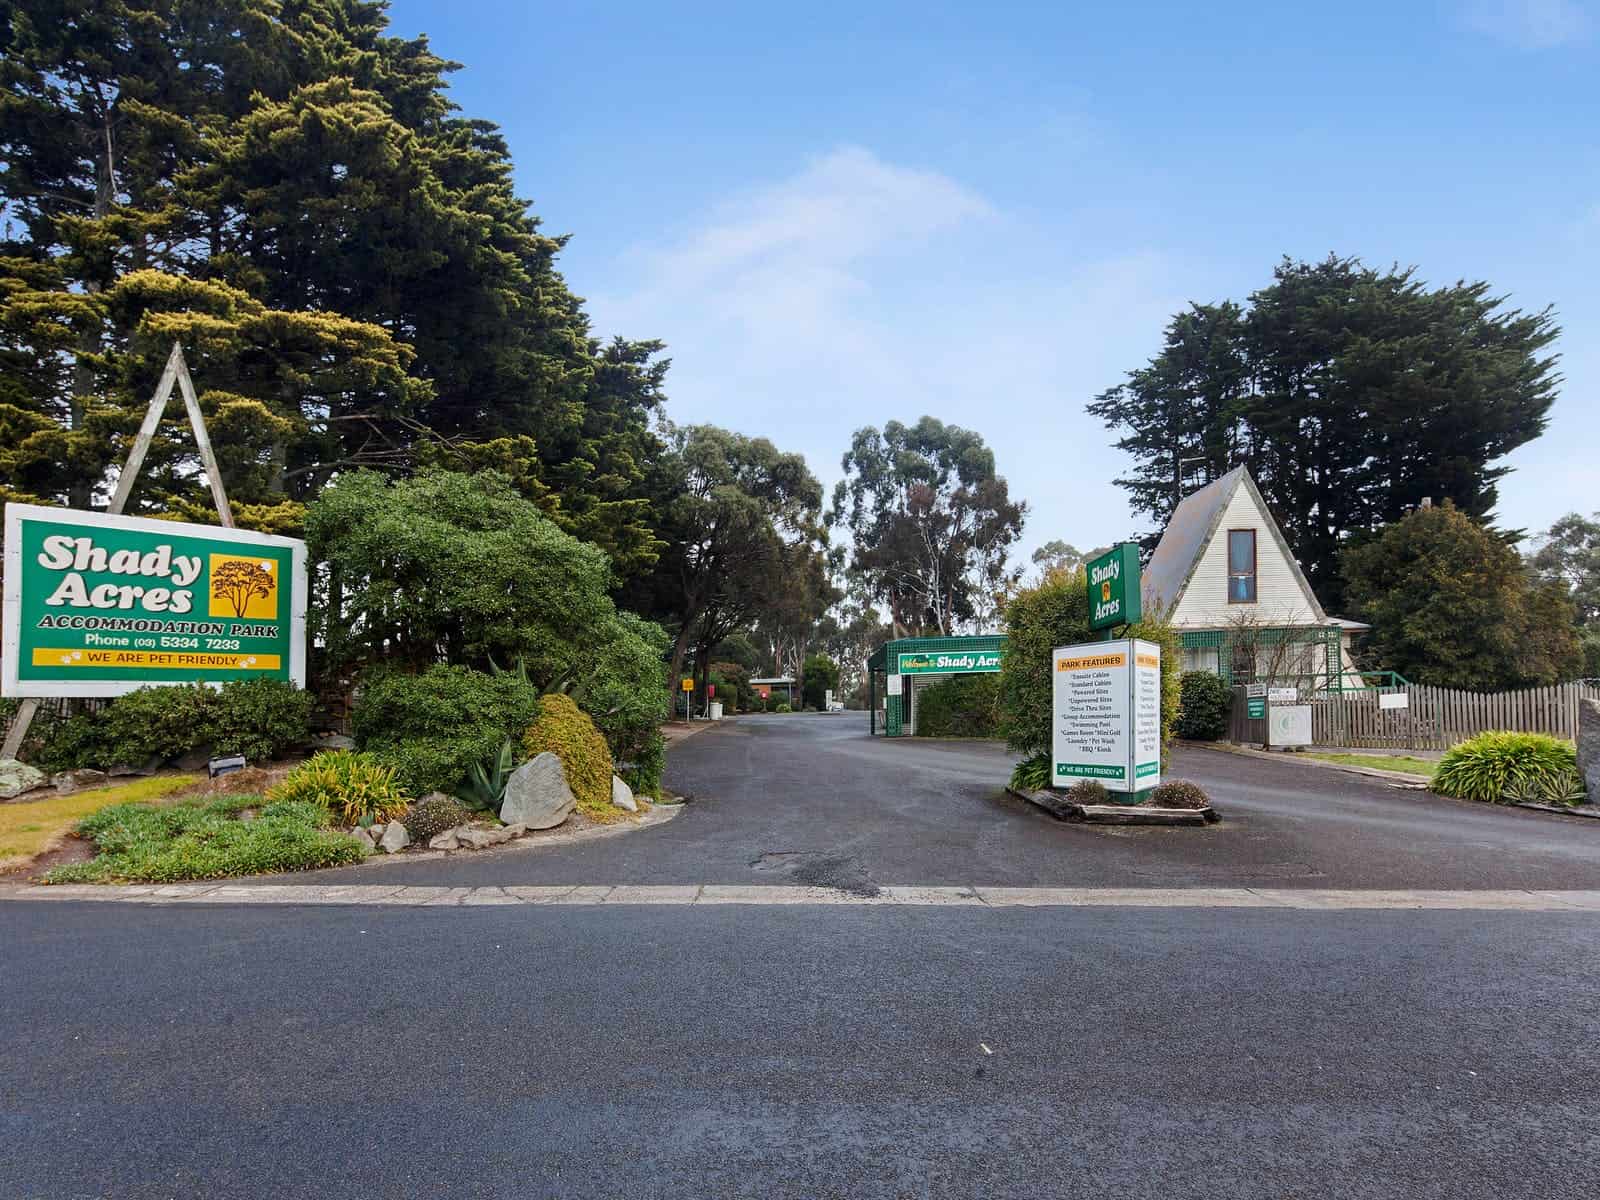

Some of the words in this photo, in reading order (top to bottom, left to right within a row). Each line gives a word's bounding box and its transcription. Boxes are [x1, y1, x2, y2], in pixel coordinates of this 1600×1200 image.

[38, 535, 201, 586] Shady
[1091, 559, 1120, 585] Shady
[46, 572, 193, 614] Acres
[1094, 599, 1120, 620] Acres
[38, 615, 225, 637] ACCOMMODATION
[230, 624, 279, 638] PARK
[85, 633, 129, 646] Phone
[134, 637, 156, 649] (03)
[160, 636, 199, 650] 5334
[205, 638, 240, 650] 7233
[87, 652, 111, 663] WE
[116, 653, 144, 664] ARE
[150, 654, 174, 665] PET
[178, 655, 237, 667] FRIENDLY
[937, 655, 975, 669] Shady
[1061, 660, 1080, 669] PARK
[1083, 656, 1121, 667] FEATURES
